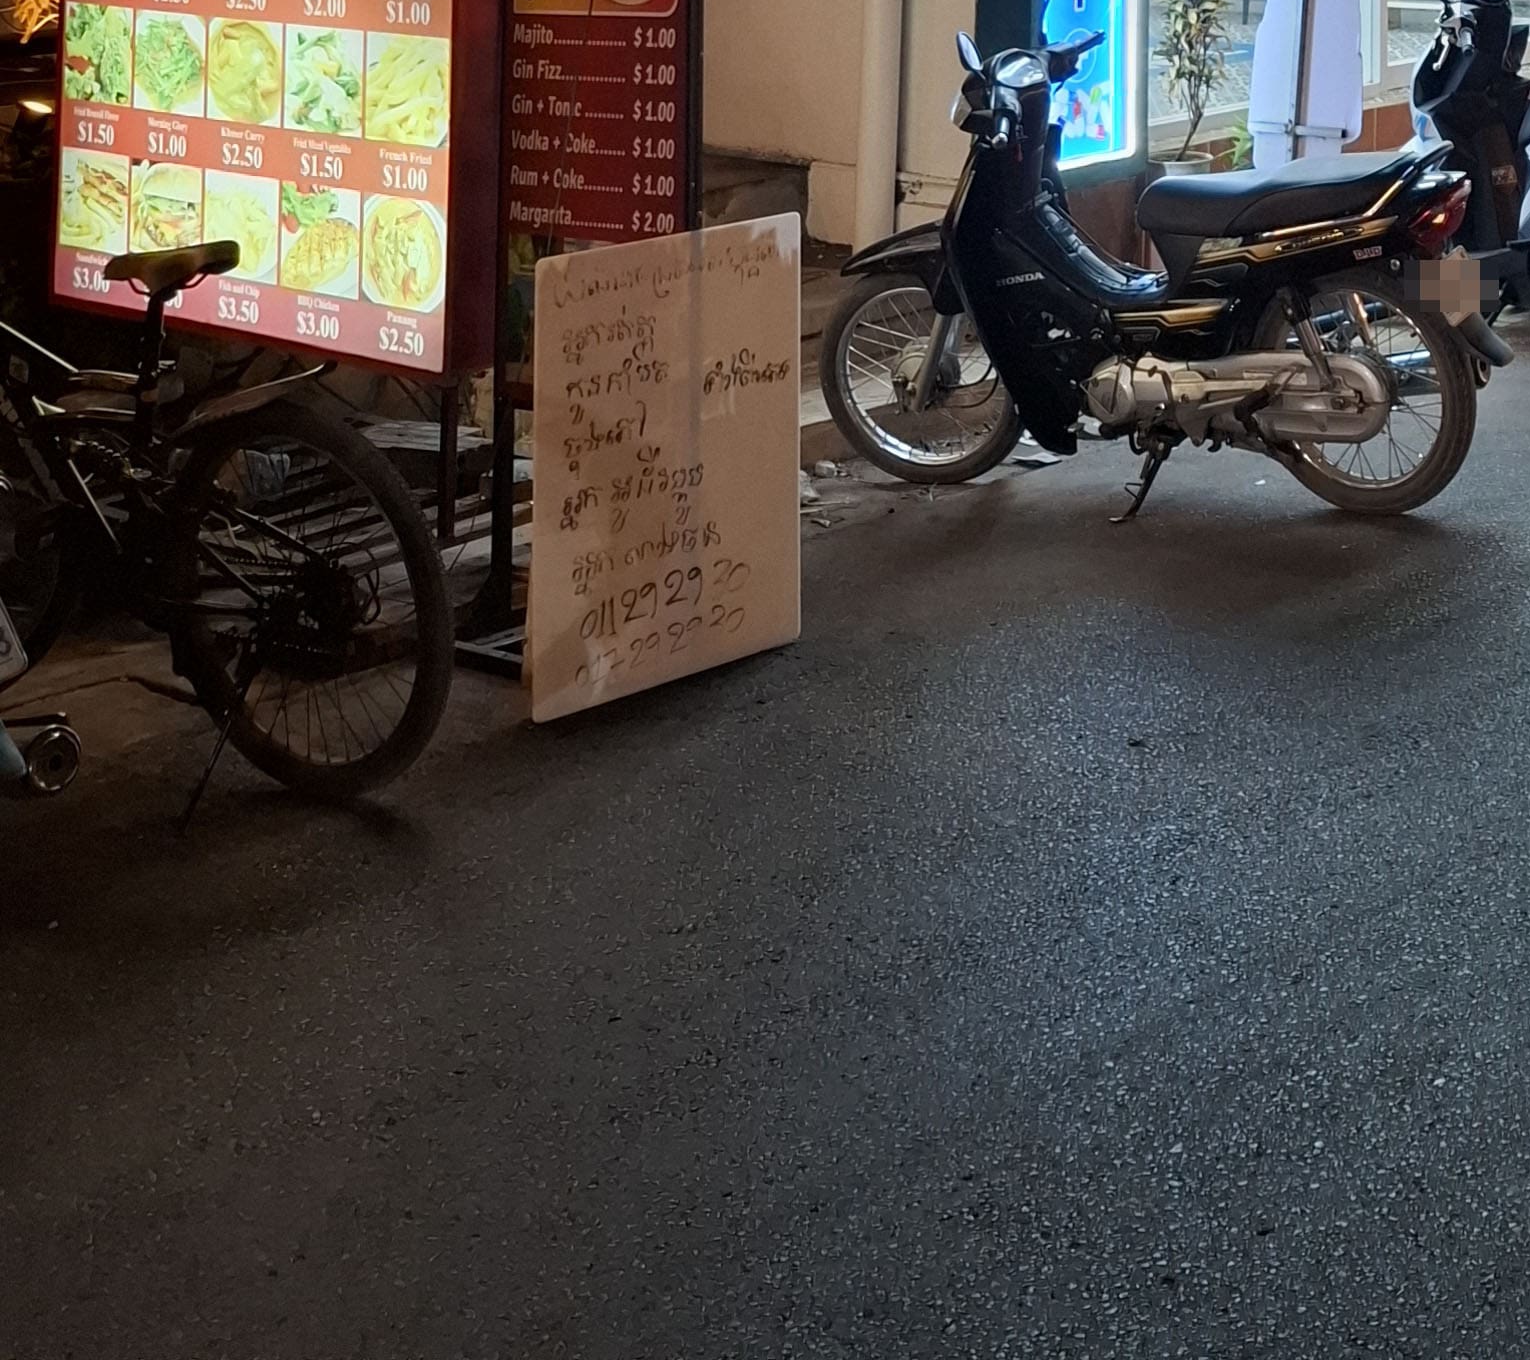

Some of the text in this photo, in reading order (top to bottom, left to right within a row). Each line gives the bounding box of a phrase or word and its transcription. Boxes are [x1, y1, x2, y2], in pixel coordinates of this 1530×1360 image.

[386, 0, 430, 25] $1.00
[513, 59, 533, 78] Gin
[538, 60, 562, 80] Fizz
[512, 95, 532, 114] Gin
[77, 120, 114, 145] $1.50
[148, 132, 187, 157] $1.00
[245, 129, 265, 143] Curry
[511, 130, 549, 151] Vodka
[222, 143, 263, 169] $2.50
[301, 153, 343, 179] $1.50
[380, 148, 408, 164] French
[383, 165, 428, 191] $1.00
[511, 165, 538, 186] Rum
[553, 168, 584, 190] Coke
[996, 272, 1046, 287] HONDA
[218, 290, 259, 324] $3.50
[297, 311, 339, 340] $3.00
[379, 327, 424, 356] $2.50
[621, 582, 657, 625] 29
[665, 566, 702, 606] 29
